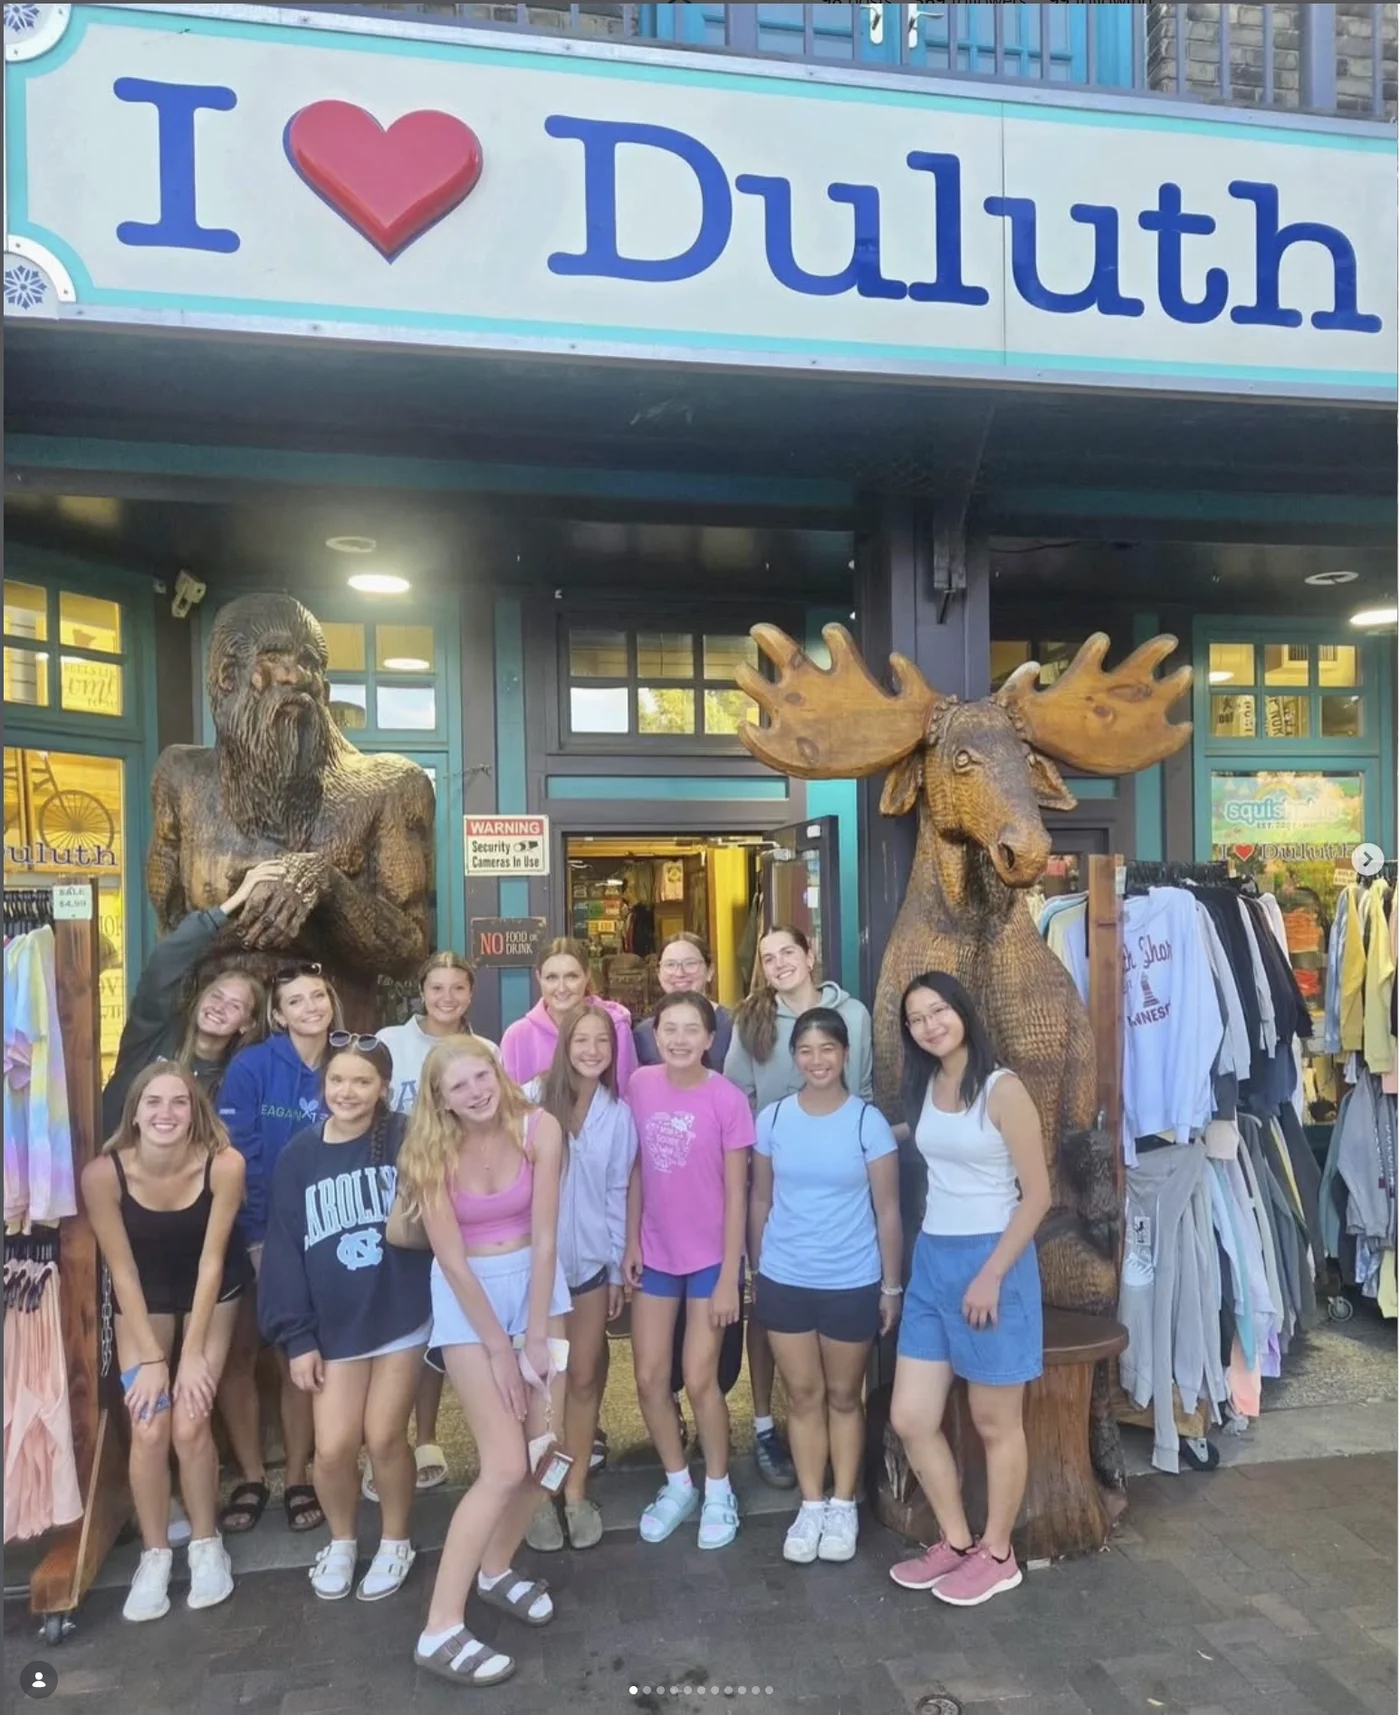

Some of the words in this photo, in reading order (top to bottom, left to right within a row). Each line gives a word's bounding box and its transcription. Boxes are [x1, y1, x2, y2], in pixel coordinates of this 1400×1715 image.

[114, 78, 238, 252] I
[545, 115, 1382, 333] Duluth
[471, 821, 540, 834] WARNING
[4, 842, 118, 866] uluth
[472, 840, 510, 855] Security
[472, 856, 510, 868] Cameras
[514, 856, 521, 868] In
[524, 856, 540, 868] Use
[480, 932, 504, 955] NO
[505, 931, 528, 943] FOOD
[505, 943, 533, 955] DRINK
[261, 1104, 302, 1121] EAGAN
